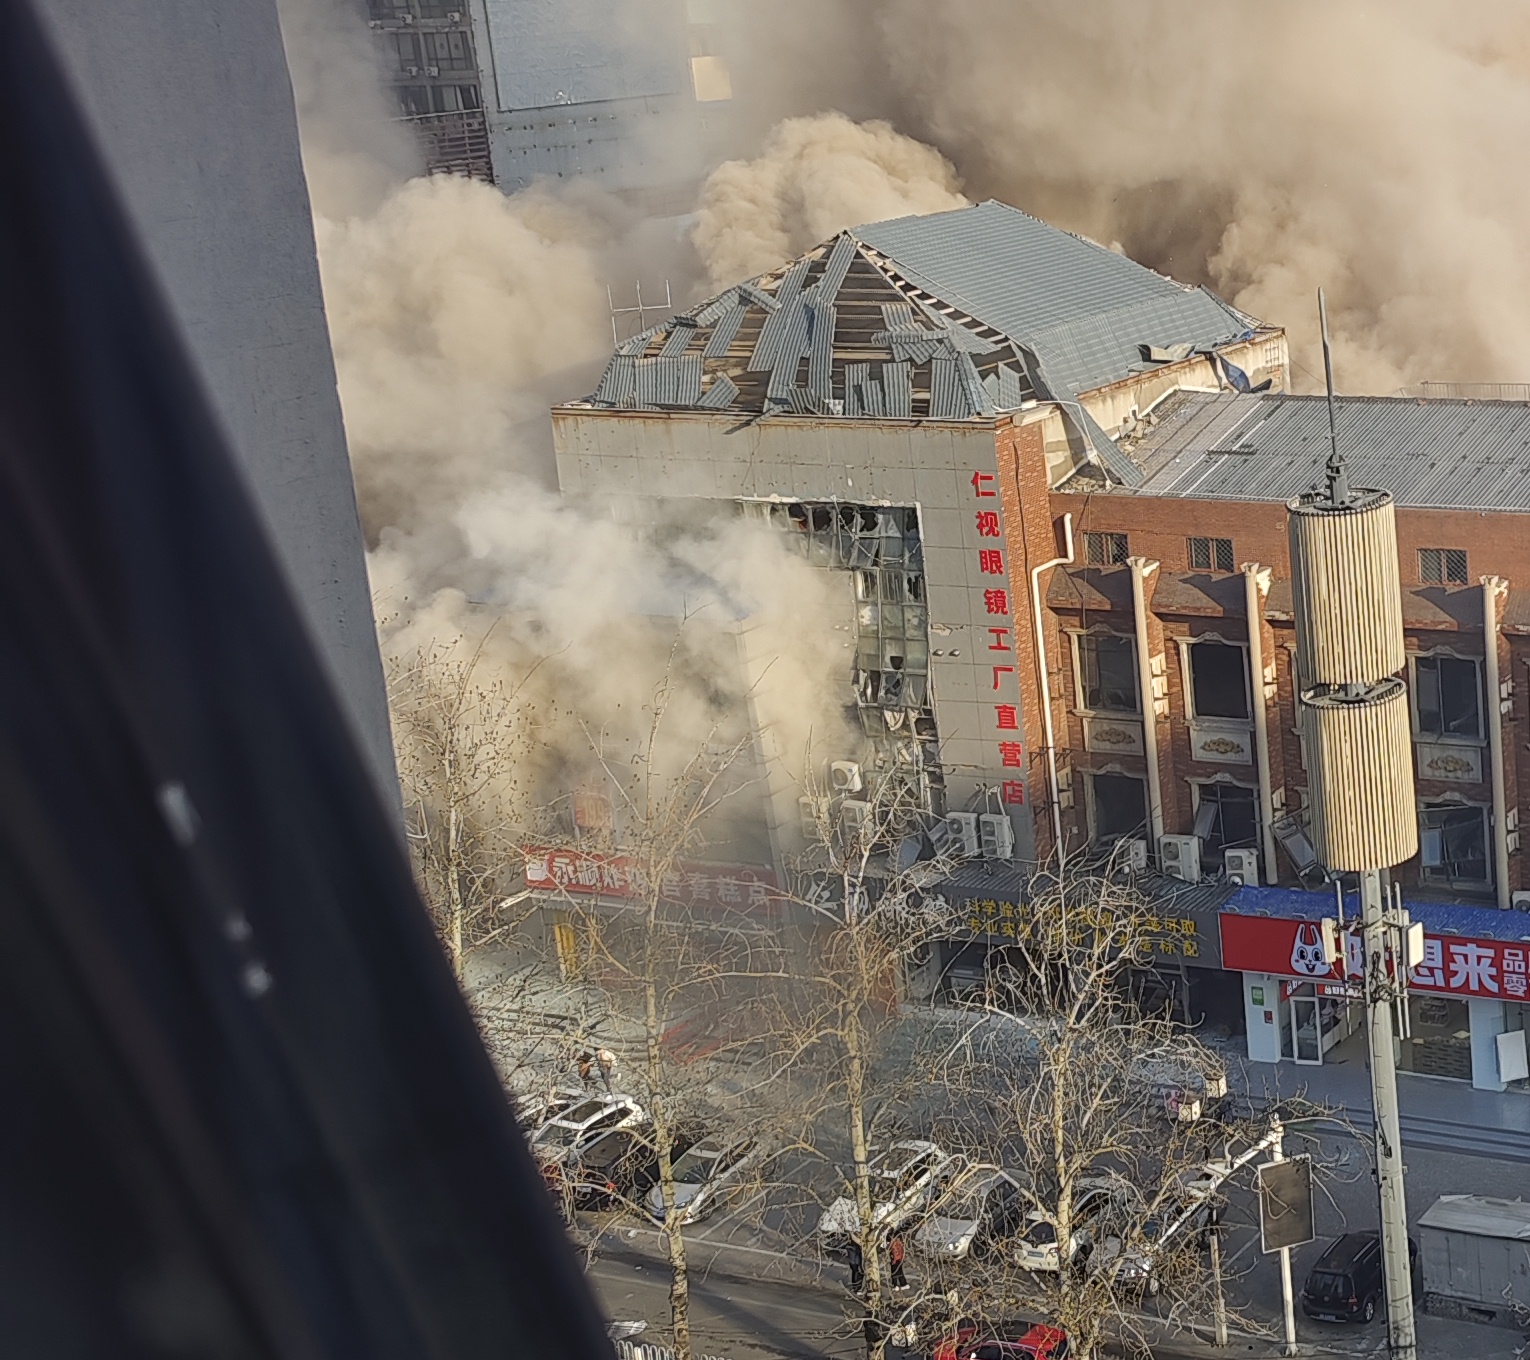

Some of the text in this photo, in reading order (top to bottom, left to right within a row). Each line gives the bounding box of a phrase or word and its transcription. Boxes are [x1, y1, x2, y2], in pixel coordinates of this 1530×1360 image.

[970, 470, 1025, 806] 仁视眼镜工厂直营店
